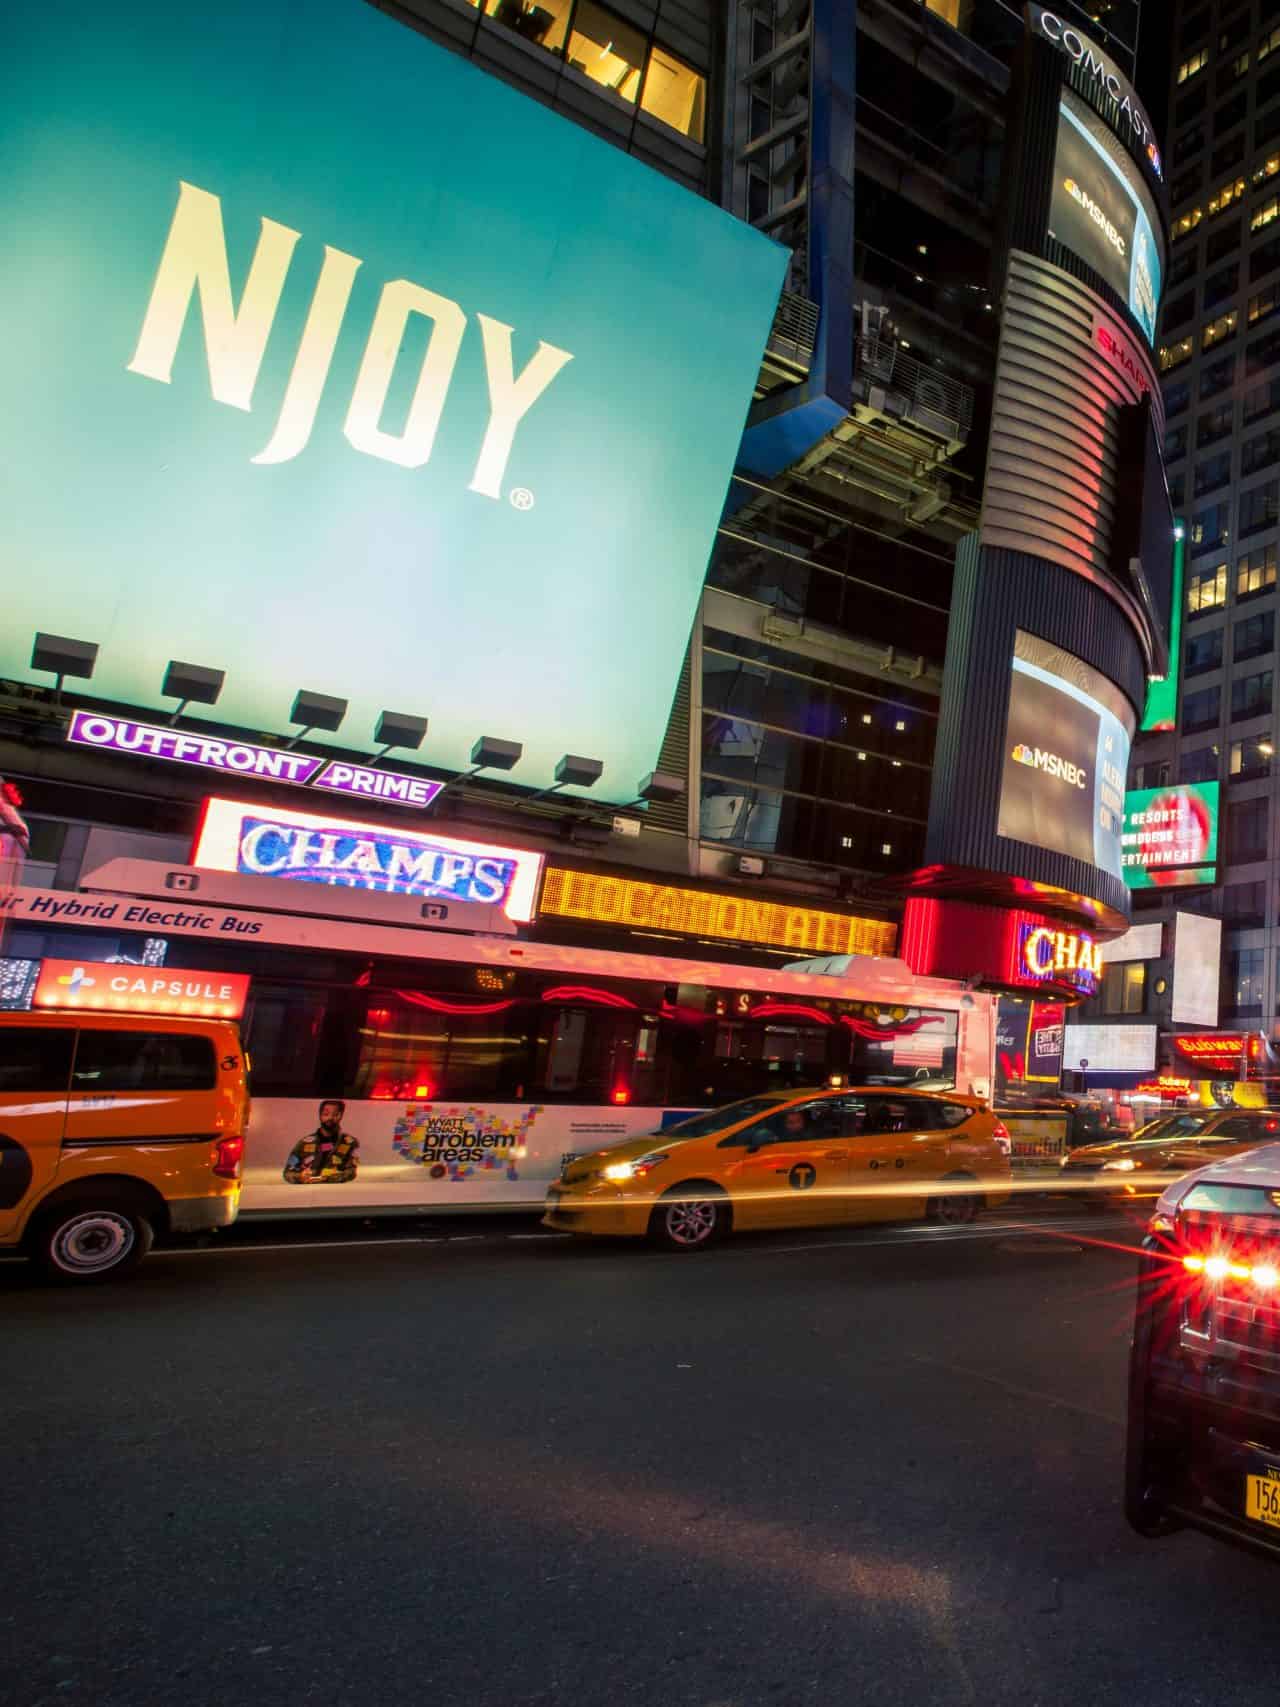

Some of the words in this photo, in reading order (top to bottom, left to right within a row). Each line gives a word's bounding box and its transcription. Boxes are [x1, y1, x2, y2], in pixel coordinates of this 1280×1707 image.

[1041, 12, 1151, 144] COMCAST
[1081, 192, 1125, 256] MSNBC
[126, 180, 575, 500] NJOY
[80, 717, 312, 781] OUTFRONT
[330, 763, 434, 803] PRIME
[1033, 747, 1087, 790] MSNBC
[242, 823, 507, 903] CHAMPS
[29, 896, 119, 918] Hybrid
[123, 906, 213, 931] Electric
[220, 913, 263, 934] Bus
[110, 976, 233, 1000] CAPSULE
[423, 1129, 516, 1150] problem
[427, 1117, 466, 1127] WYATT
[421, 1147, 484, 1162] areas
